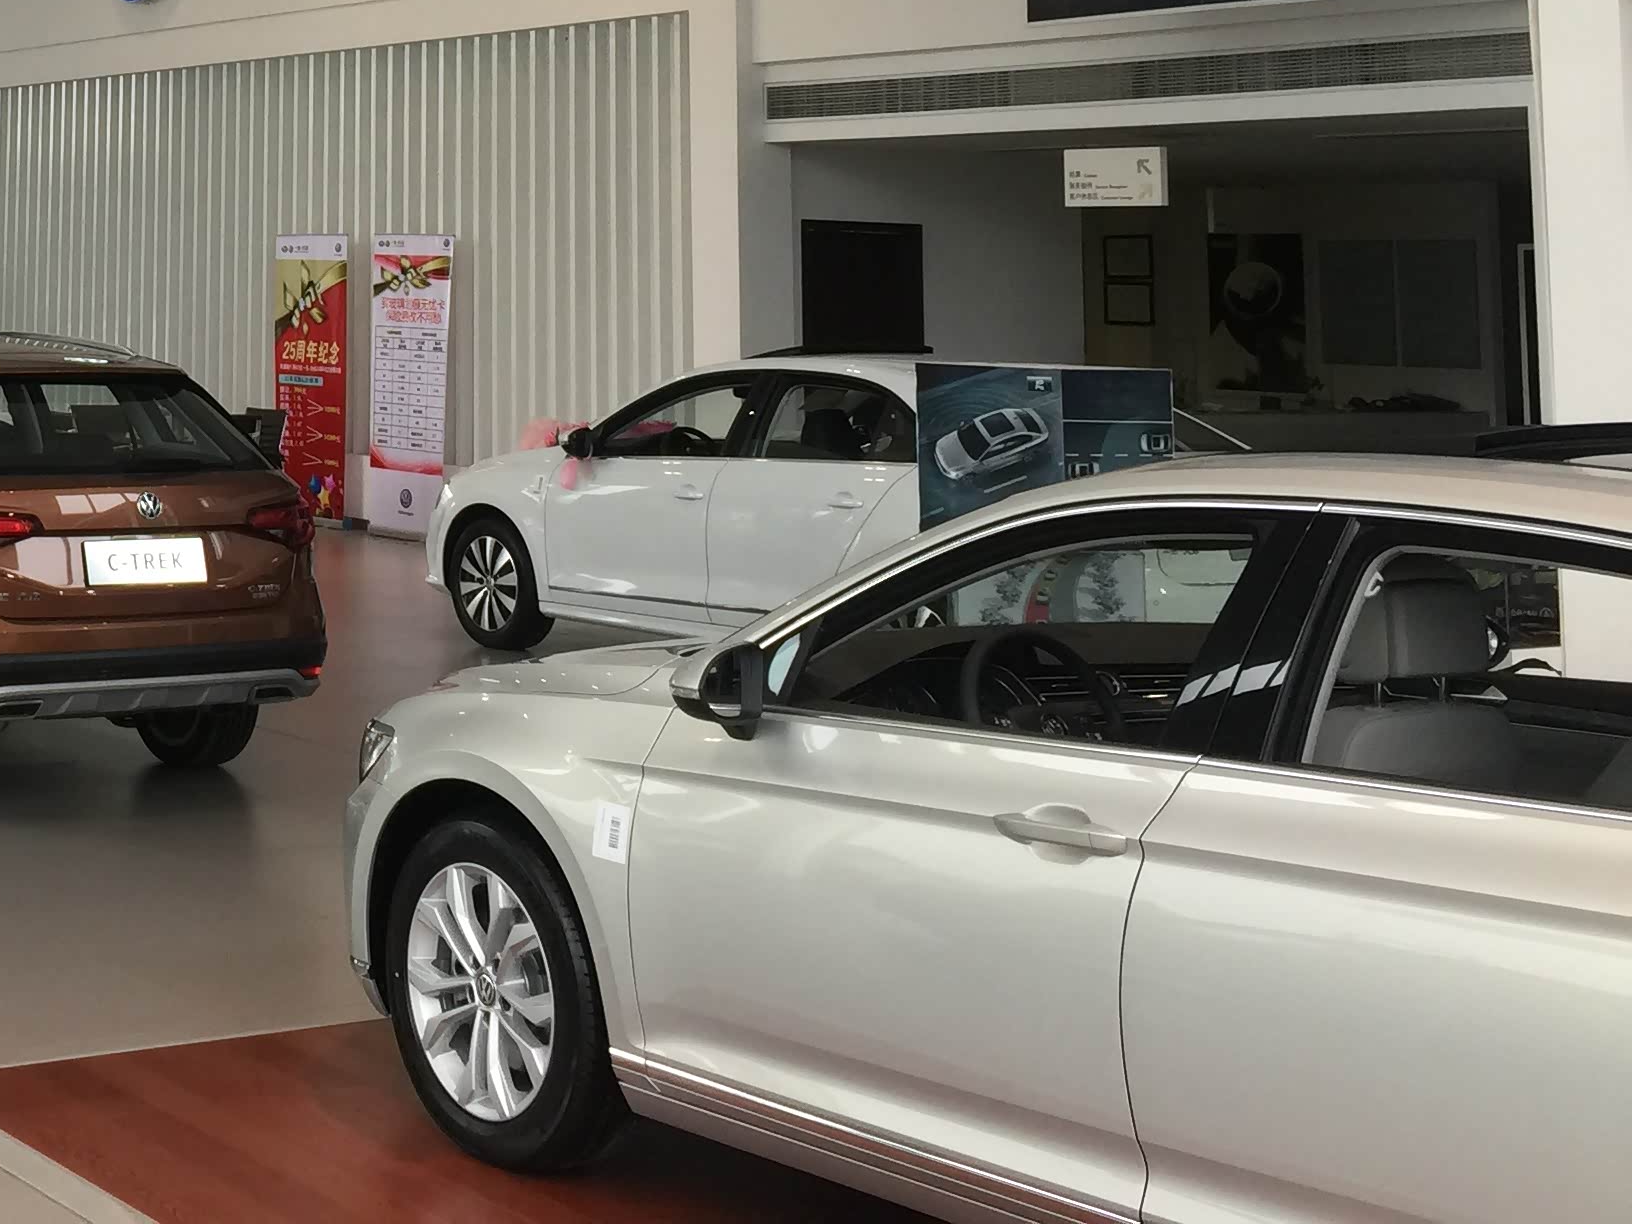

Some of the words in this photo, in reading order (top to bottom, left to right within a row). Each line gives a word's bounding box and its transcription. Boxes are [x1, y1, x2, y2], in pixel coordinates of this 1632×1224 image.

[281, 340, 340, 365] 25周年纪念
[107, 552, 184, 572] C-TREK
